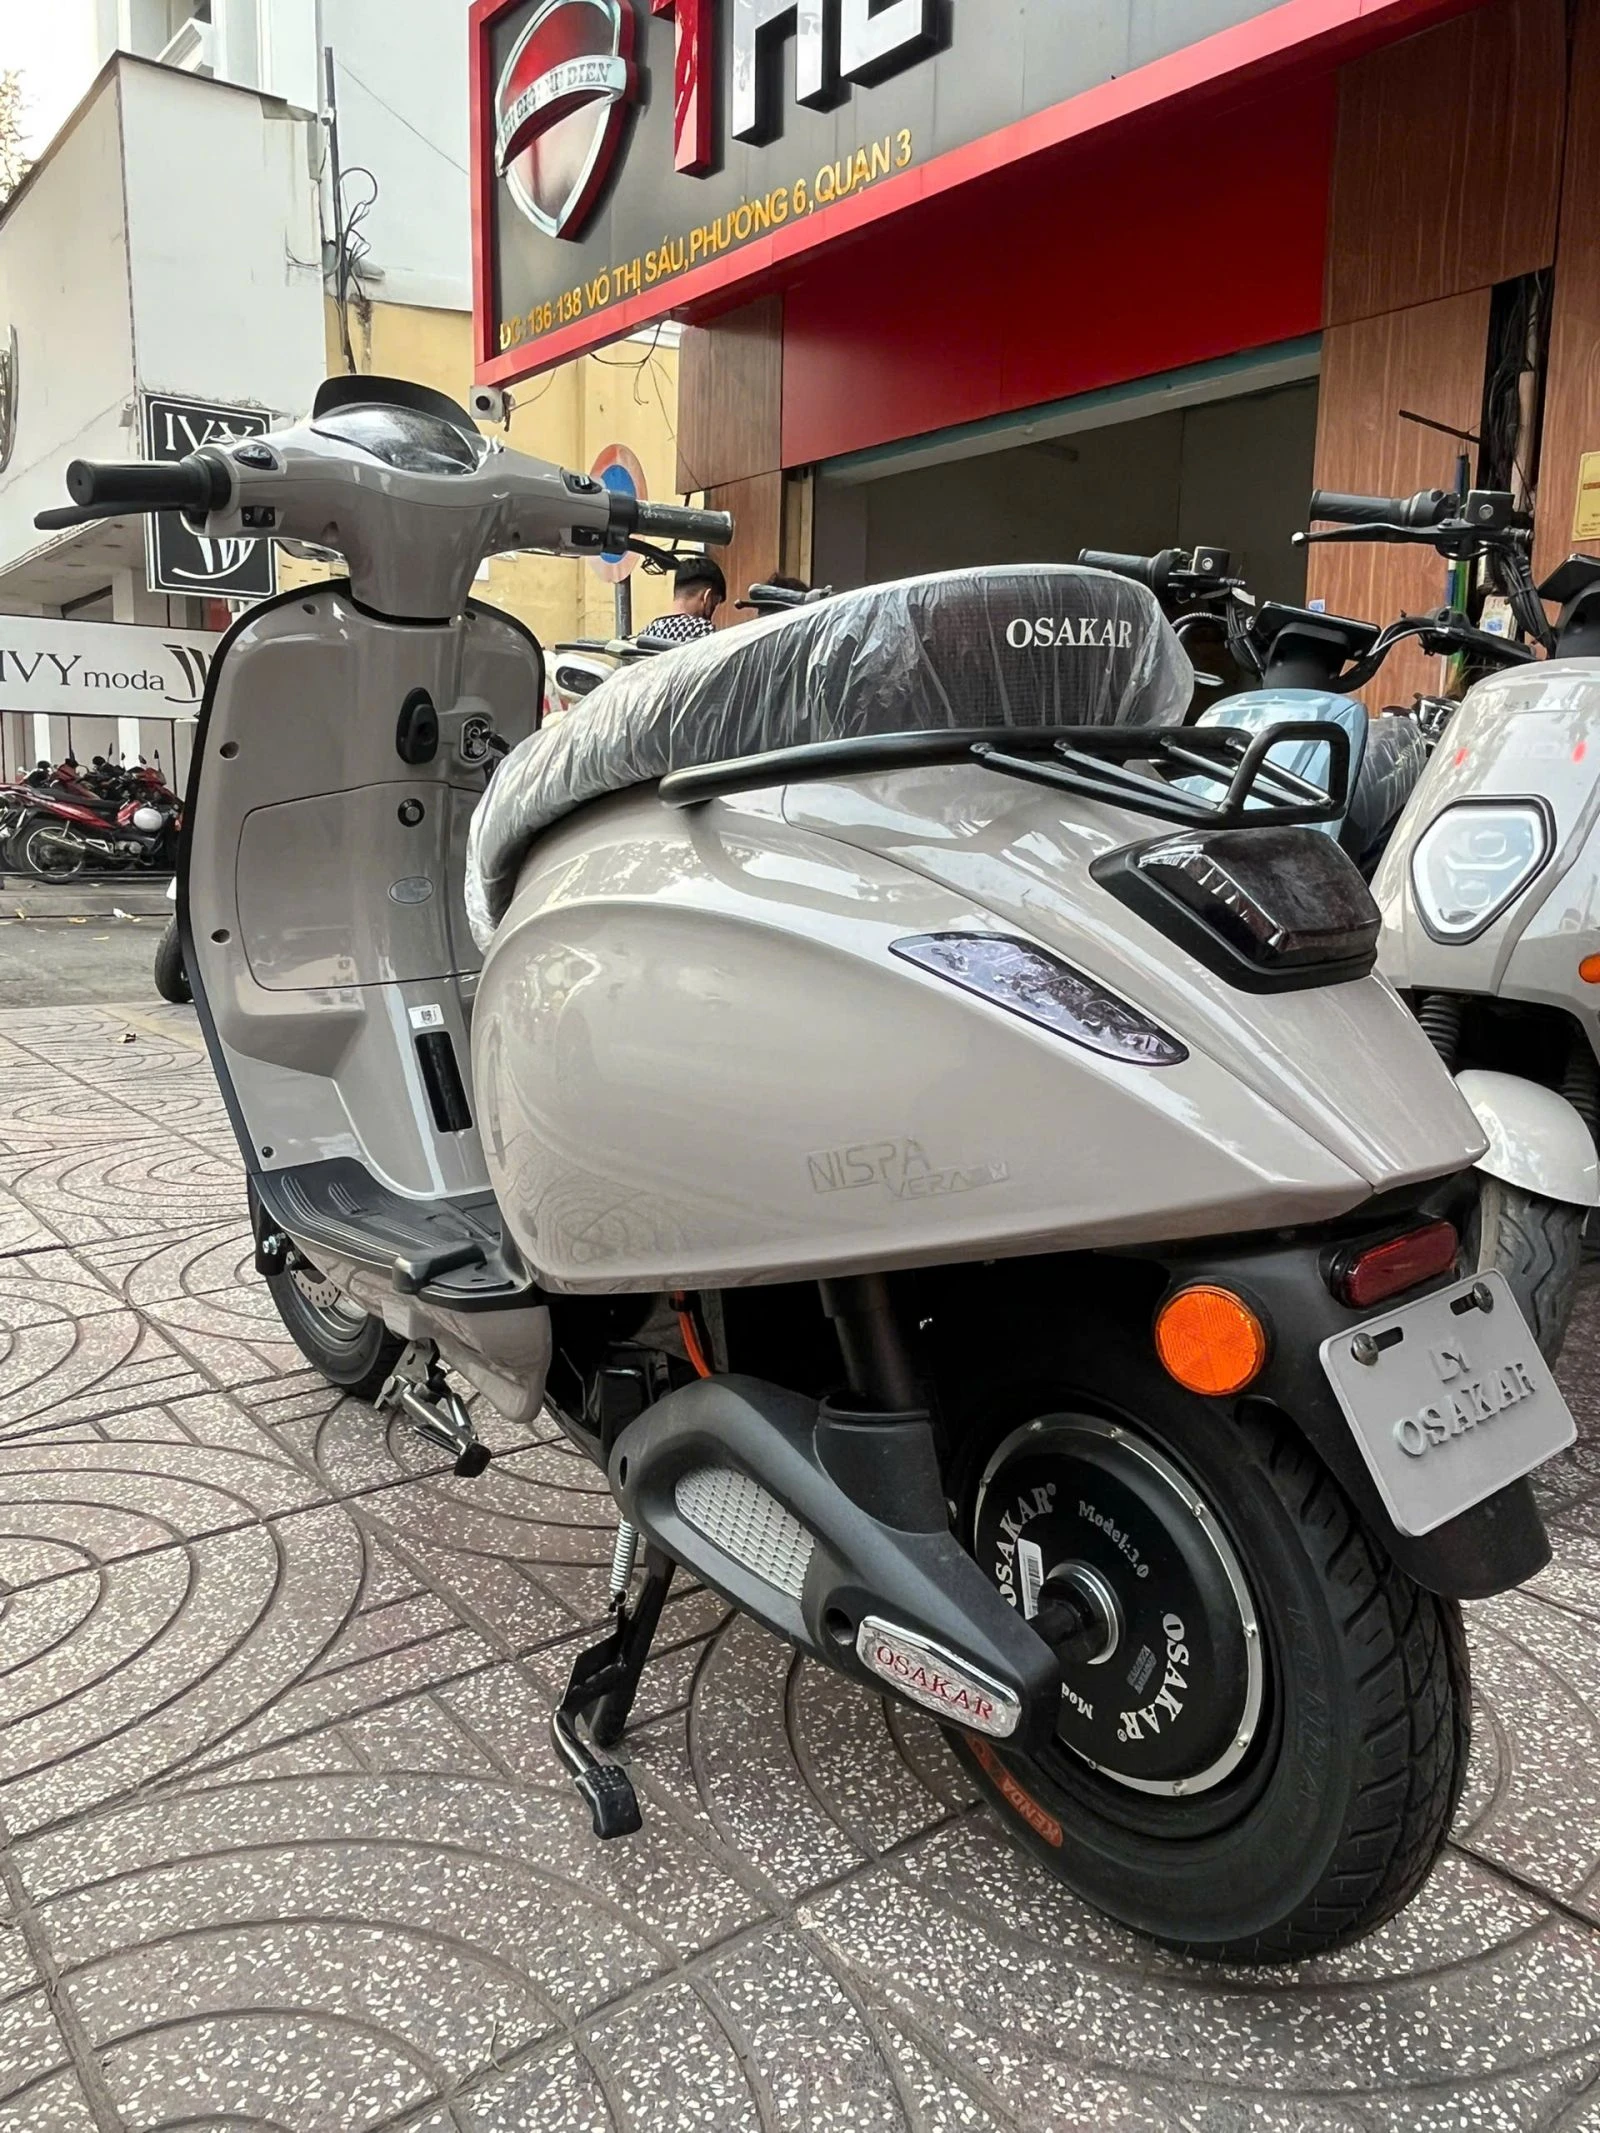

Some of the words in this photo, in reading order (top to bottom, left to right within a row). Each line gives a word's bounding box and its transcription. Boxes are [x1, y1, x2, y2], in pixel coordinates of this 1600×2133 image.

[585, 265, 610, 310] VÕ
[612, 257, 641, 296] THỊ
[896, 128, 912, 168] 3
[1006, 617, 1132, 648] OSAKAR
[84, 670, 165, 691] moda
[1393, 1361, 1536, 1458] OSAKAR
[877, 1645, 993, 1720] OSAKAR
